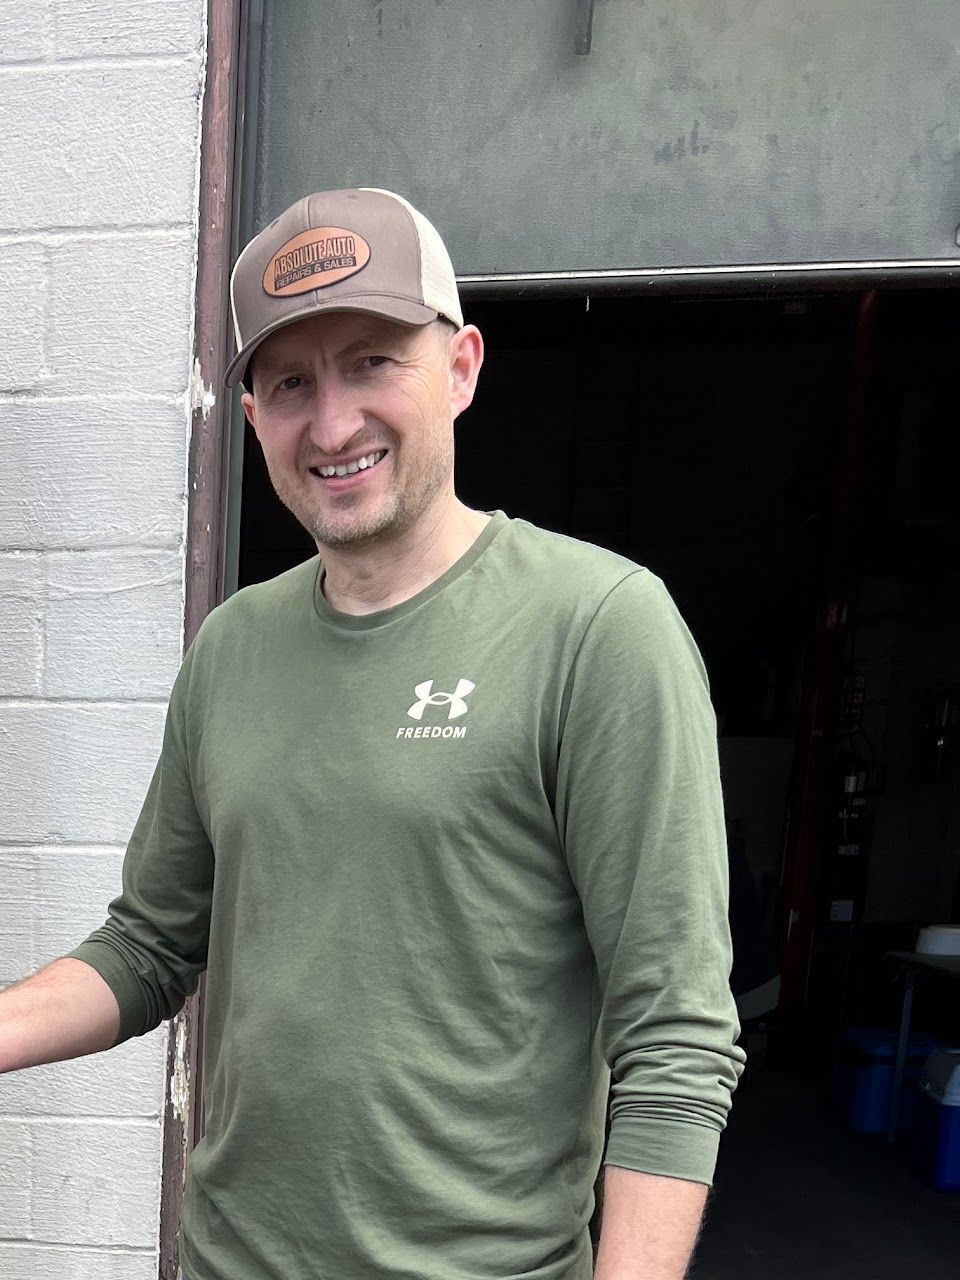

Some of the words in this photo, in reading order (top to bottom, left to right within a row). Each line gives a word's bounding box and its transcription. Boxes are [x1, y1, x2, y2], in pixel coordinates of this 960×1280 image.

[274, 240, 326, 279] ABSOLUTE
[326, 236, 355, 257] AUTO
[276, 267, 312, 288] REPAIRS
[314, 265, 322, 273] &
[324, 258, 354, 270] SALES
[396, 726, 467, 739] FREEDOM
